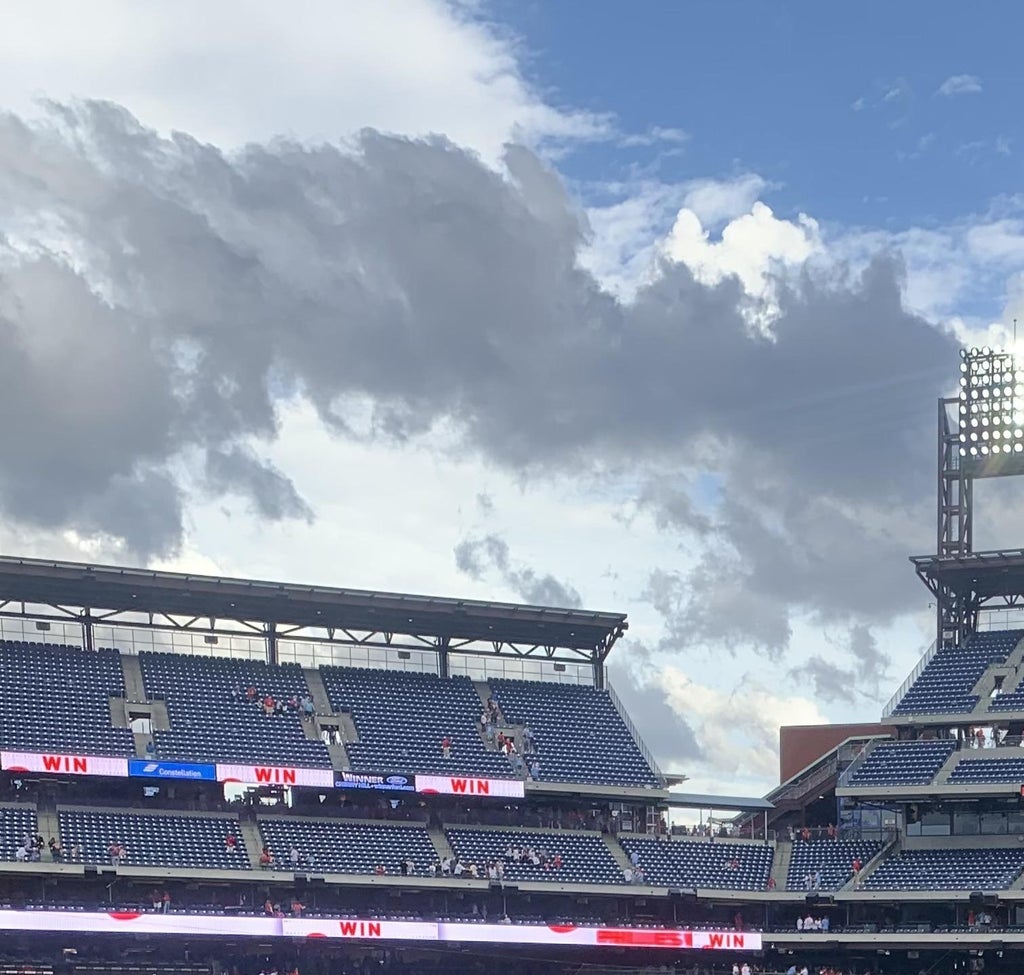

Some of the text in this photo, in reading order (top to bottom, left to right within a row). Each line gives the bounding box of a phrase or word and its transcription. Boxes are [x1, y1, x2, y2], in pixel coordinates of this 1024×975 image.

[42, 755, 87, 773] WIN
[159, 768, 202, 778] Constellation
[254, 768, 296, 784] WIN
[342, 772, 384, 784] WINNER
[450, 778, 489, 794] WIN
[339, 921, 381, 937] WIN
[708, 933, 745, 949] WIN
